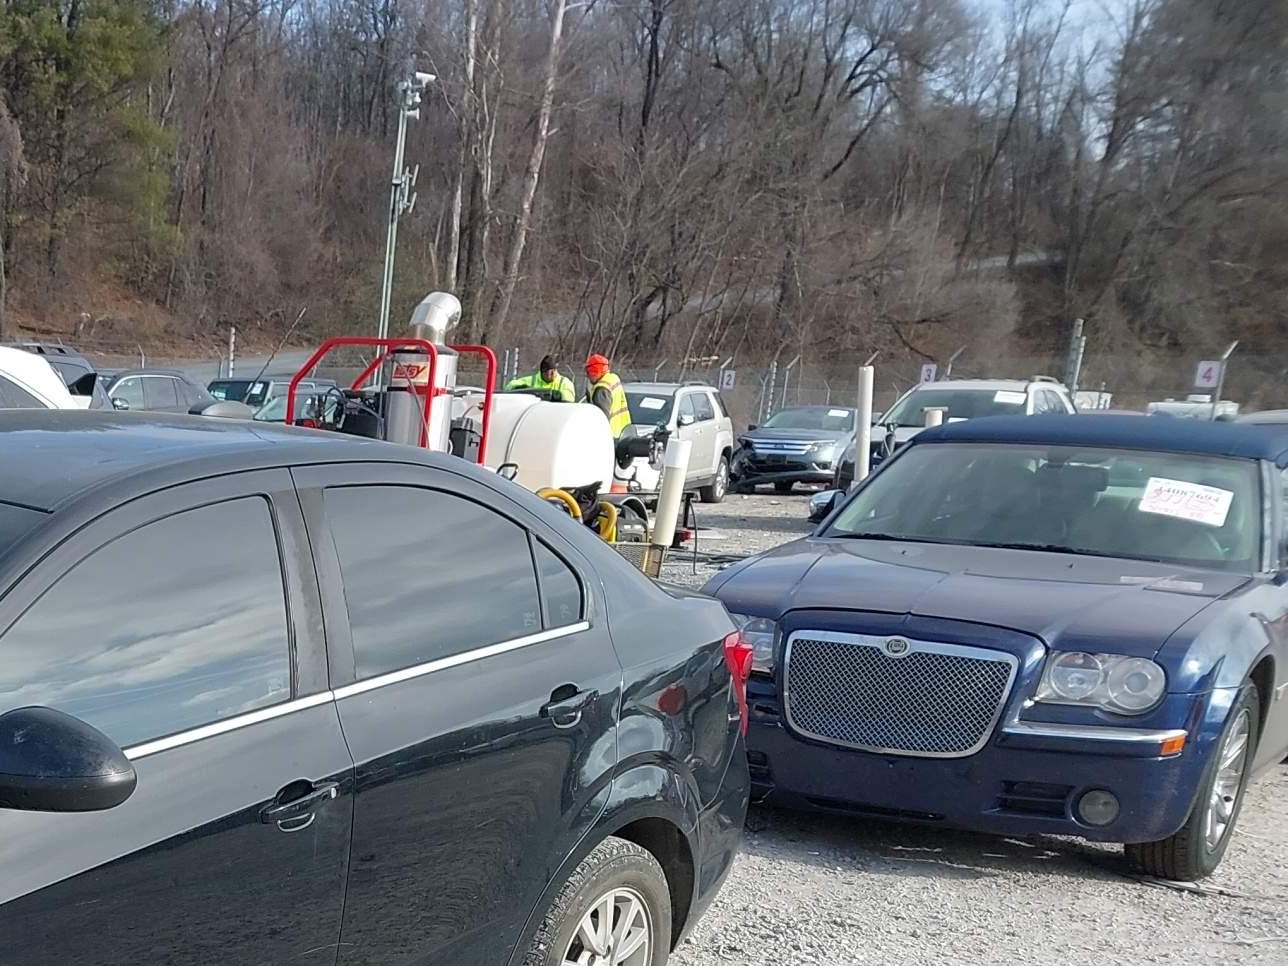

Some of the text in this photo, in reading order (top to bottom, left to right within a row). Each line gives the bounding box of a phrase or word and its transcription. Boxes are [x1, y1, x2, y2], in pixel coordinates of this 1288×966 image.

[726, 374, 732, 386] 2
[924, 368, 932, 382] 3
[1202, 367, 1213, 383] 4
